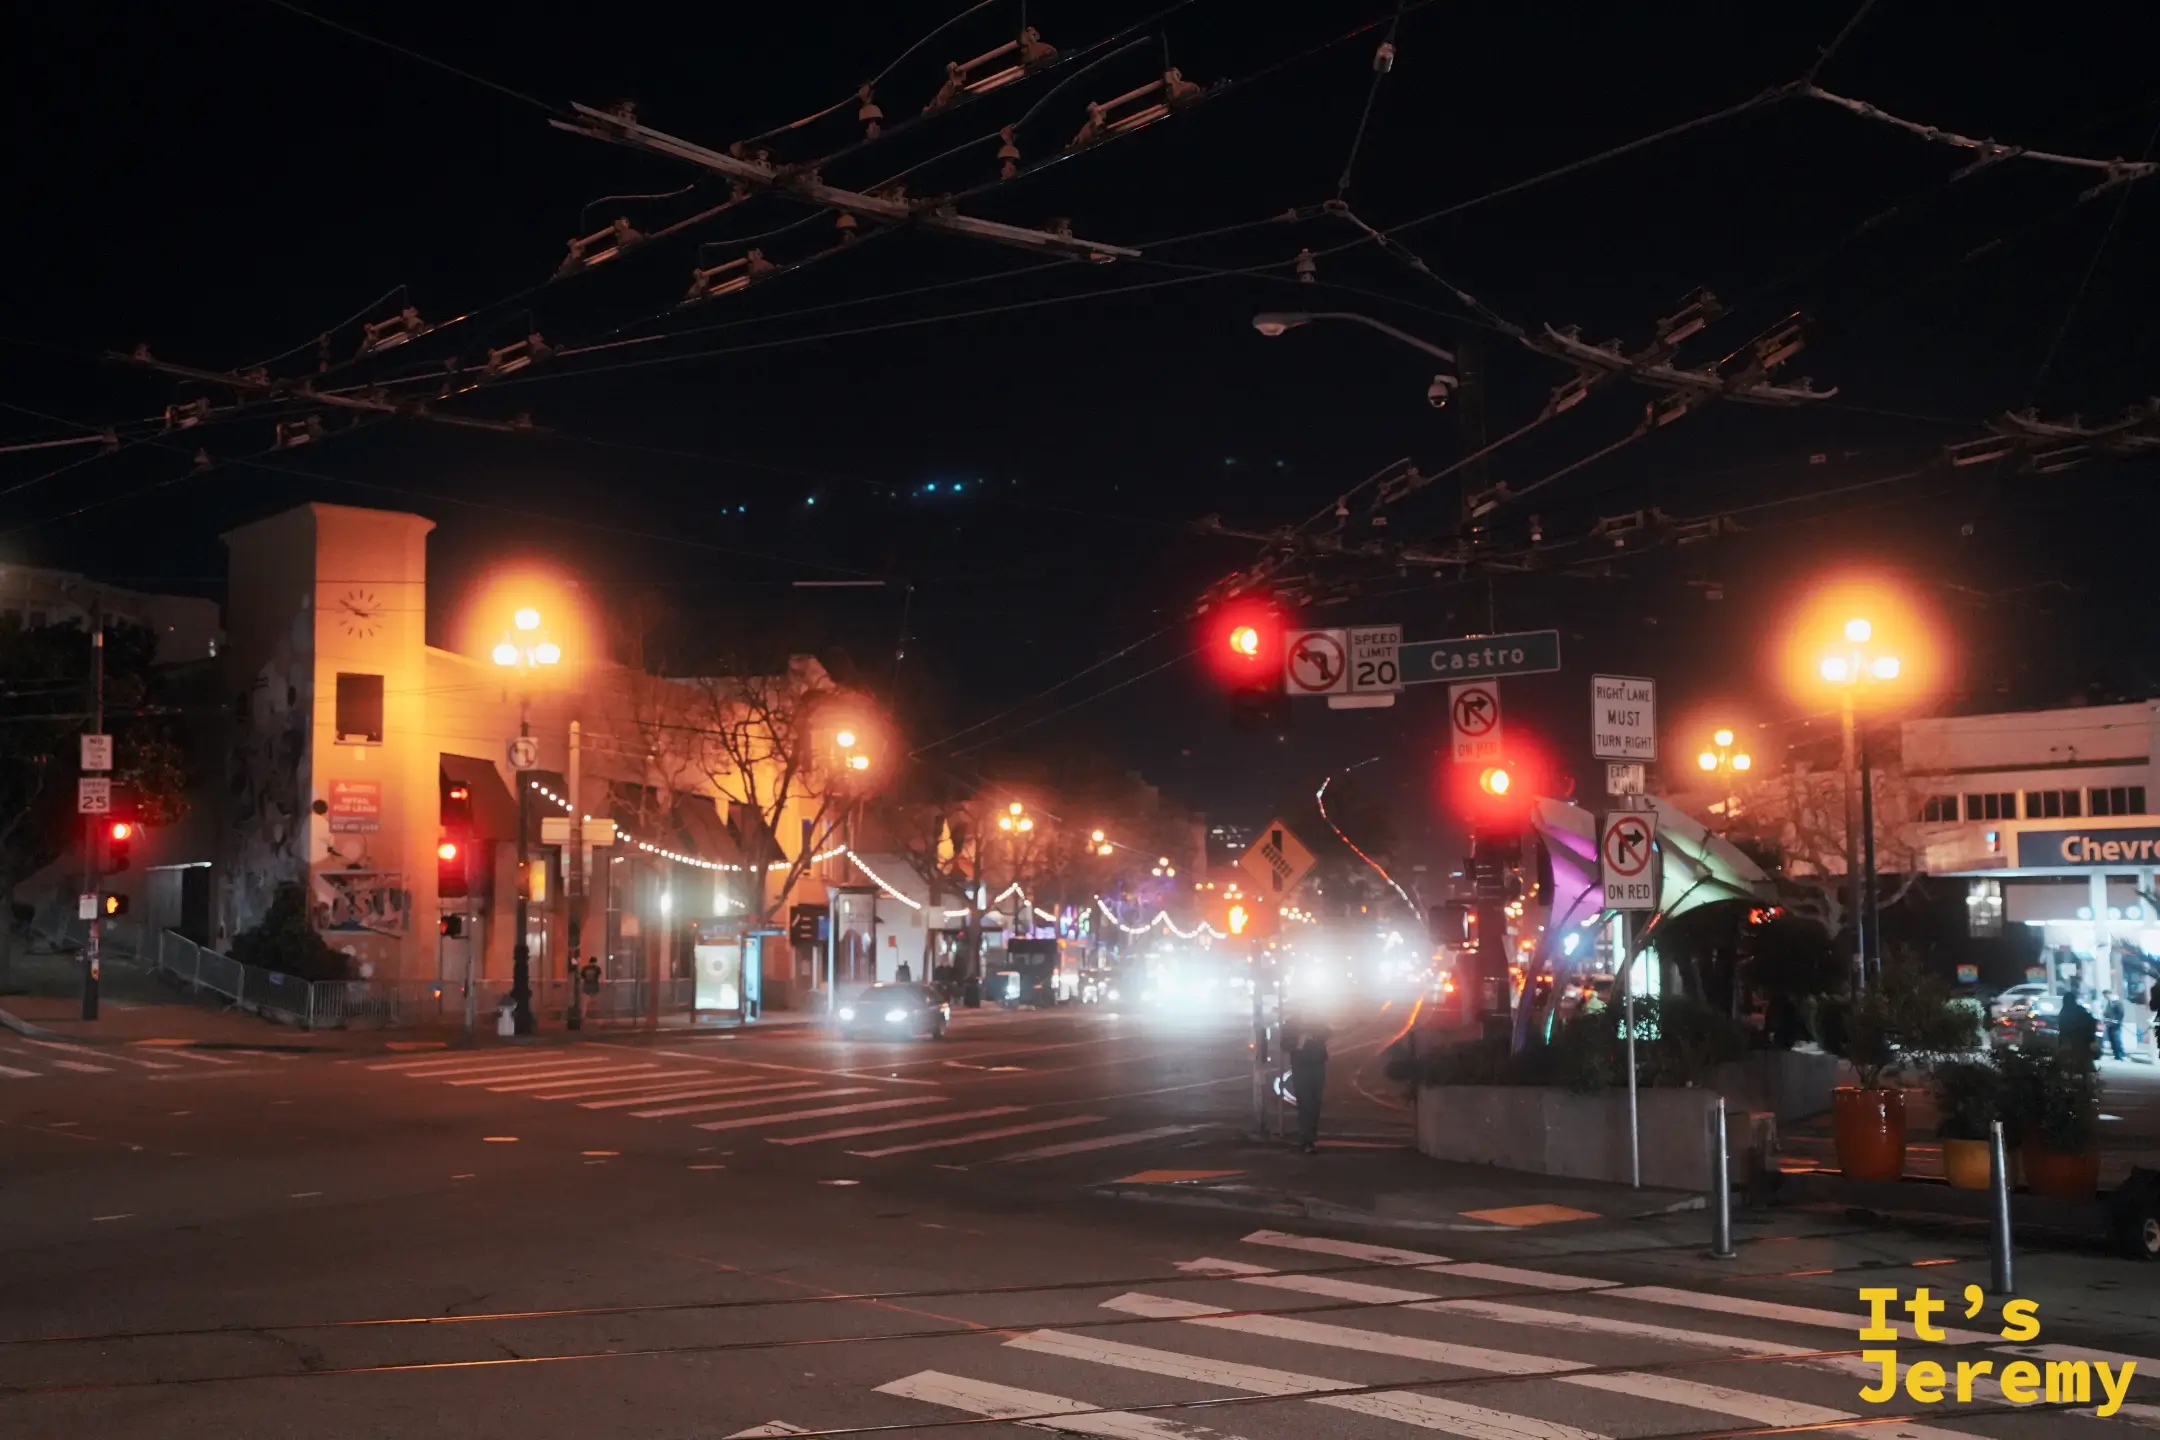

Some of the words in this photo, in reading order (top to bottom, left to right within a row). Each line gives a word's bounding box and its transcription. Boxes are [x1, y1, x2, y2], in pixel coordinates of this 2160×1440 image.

[1354, 633, 1398, 645] SPEED
[1359, 646, 1392, 658] LIMIT
[1430, 647, 1524, 671] Castro
[1356, 661, 1397, 685] 20
[1596, 686, 1624, 701] RIGHT
[1627, 688, 1651, 702] LANE
[1607, 709, 1640, 727] MUST
[1596, 734, 1622, 747] TURN
[1625, 735, 1653, 749] RIGHT
[1459, 744, 1473, 757] ON
[82, 796, 107, 810] 25
[1608, 884, 1624, 900] ON
[1628, 884, 1650, 900] RED
